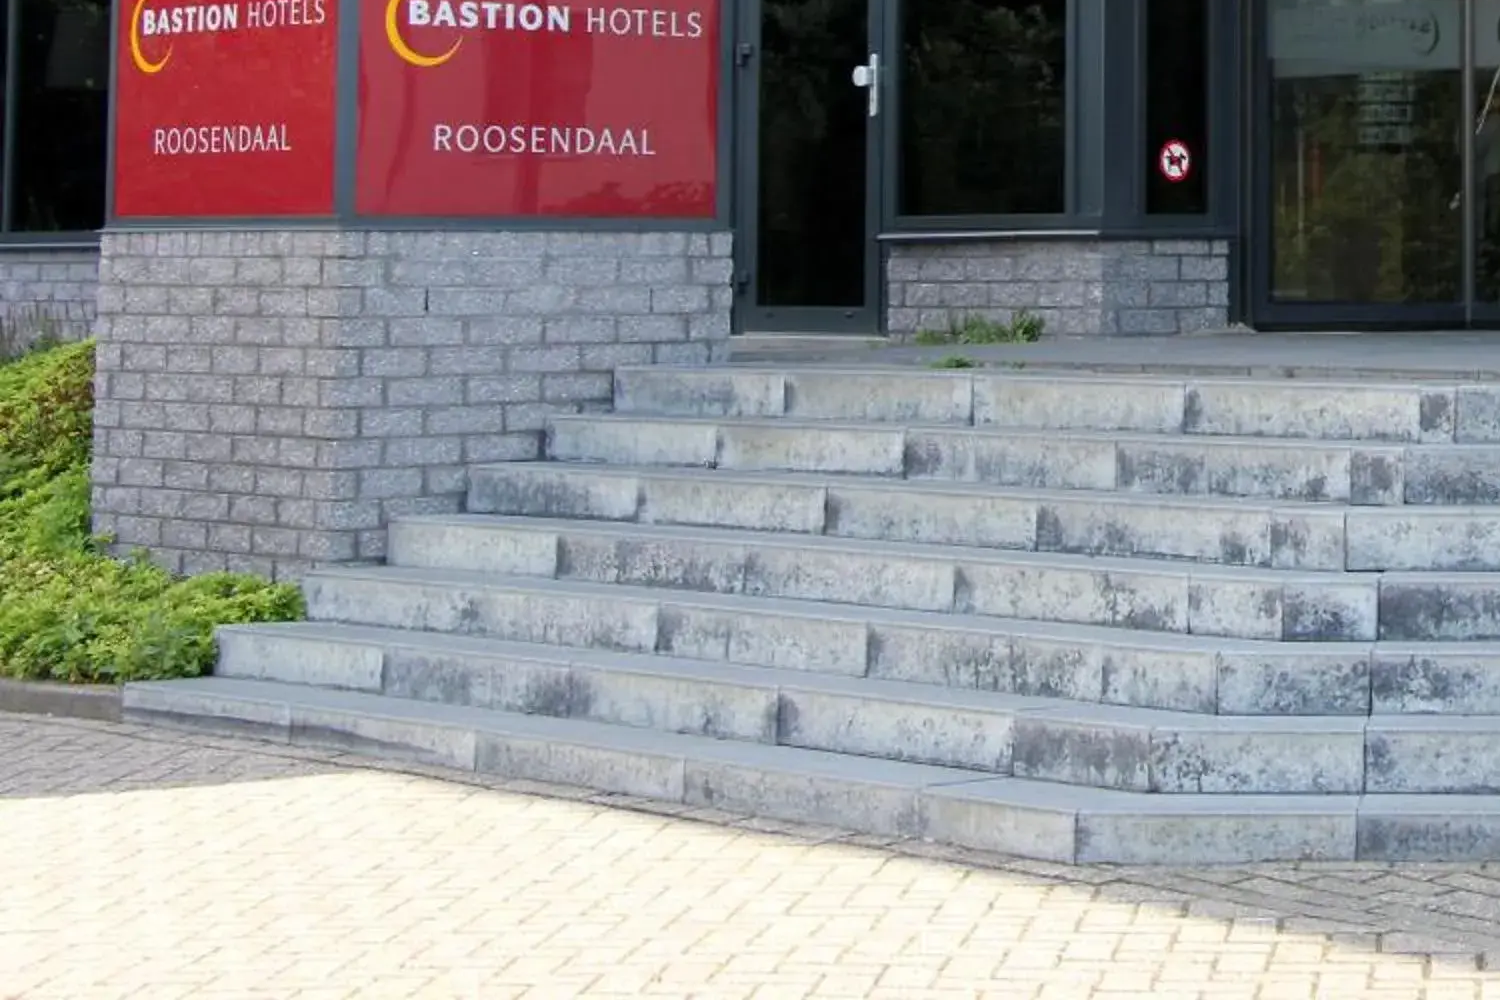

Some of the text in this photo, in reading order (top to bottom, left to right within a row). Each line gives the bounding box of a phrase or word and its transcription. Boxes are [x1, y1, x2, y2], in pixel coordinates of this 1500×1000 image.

[143, 4, 238, 35] BASTION
[408, 0, 703, 37] BASTION HOTELS
[155, 125, 292, 154] ROOSENDAAL
[433, 125, 656, 155] ROOSENDAAL
